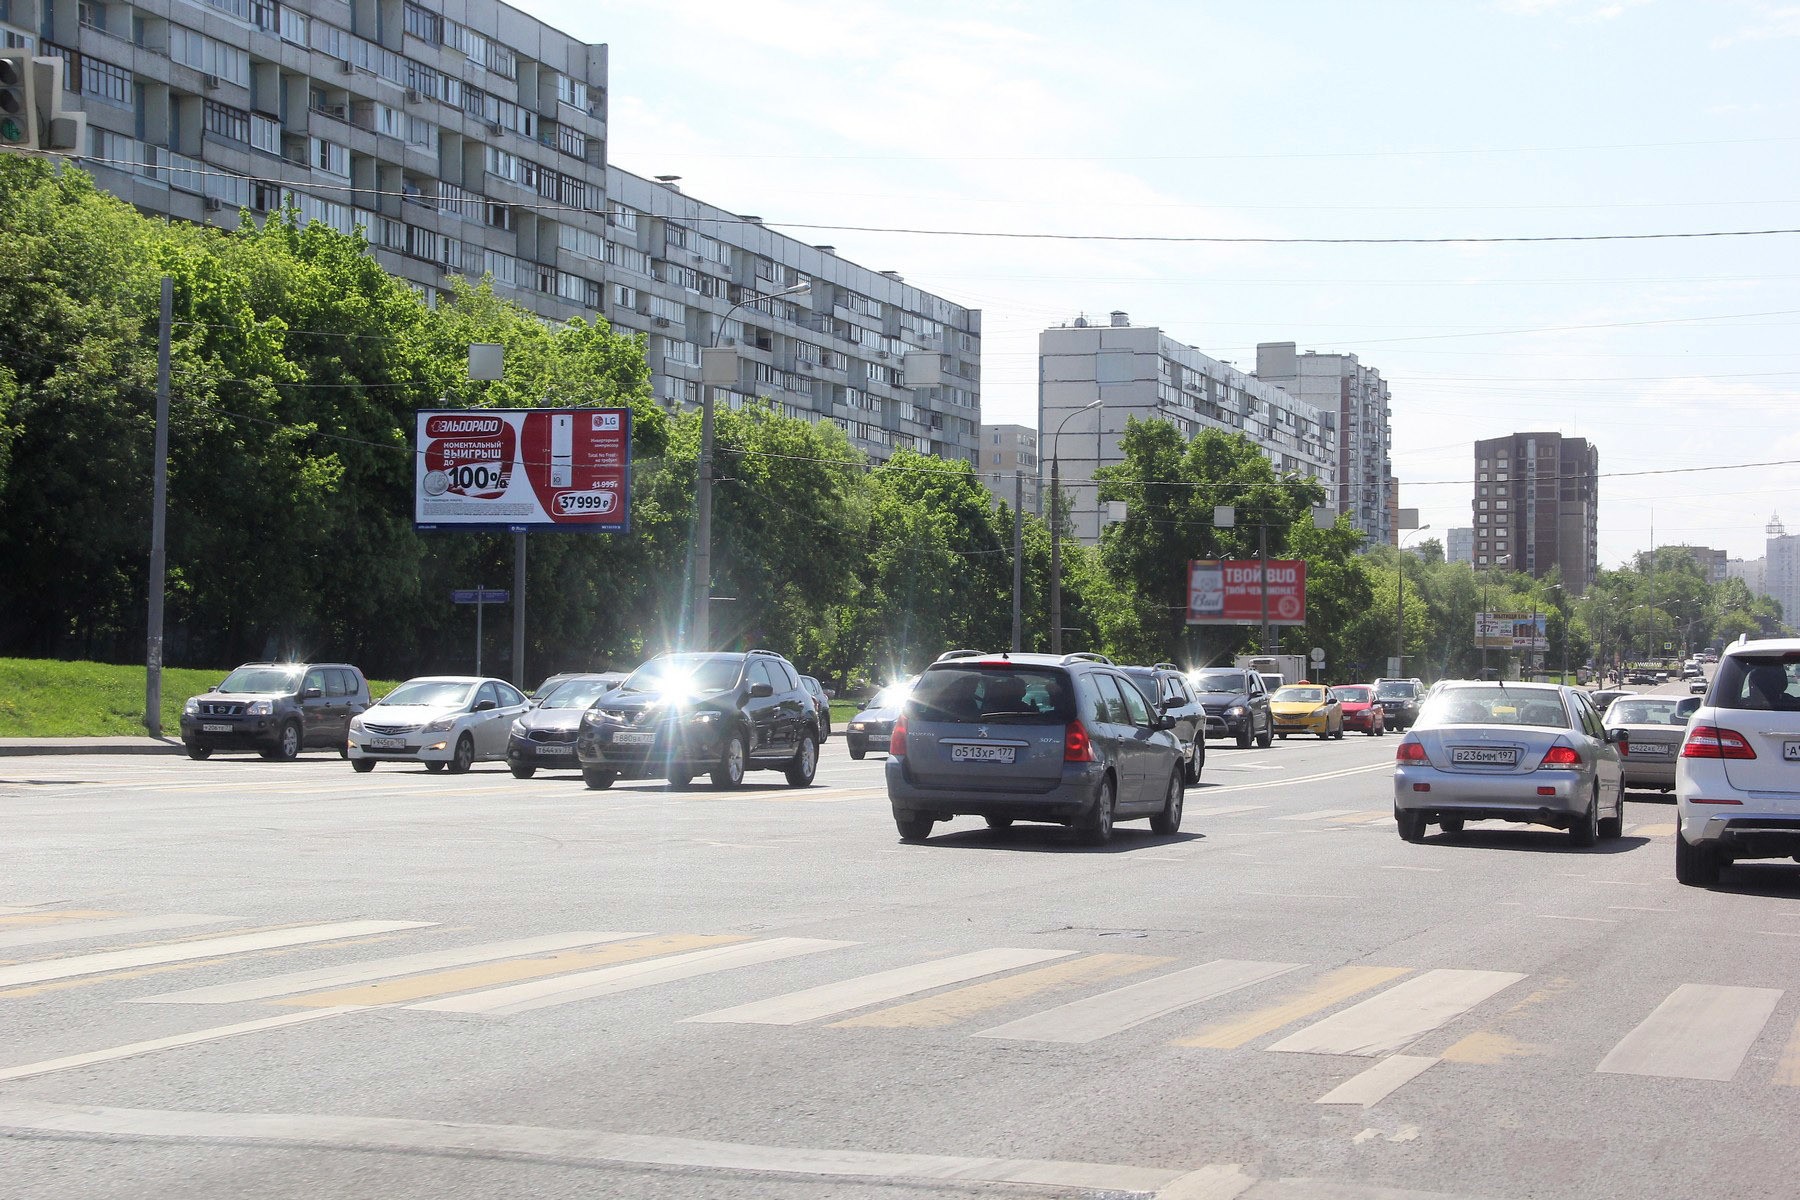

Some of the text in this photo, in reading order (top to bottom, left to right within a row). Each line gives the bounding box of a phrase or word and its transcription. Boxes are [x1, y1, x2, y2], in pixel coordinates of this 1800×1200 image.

[605, 417, 616, 425] LG
[443, 449, 502, 459] ВЫИГРЫШ
[448, 466, 509, 489] 100%
[1225, 564, 1262, 583] ТВОЙ
[1225, 583, 1246, 595] ТВОЙ
[955, 747, 1013, 757] О513ХР 177
[1457, 750, 1512, 761] В236ММ 197
